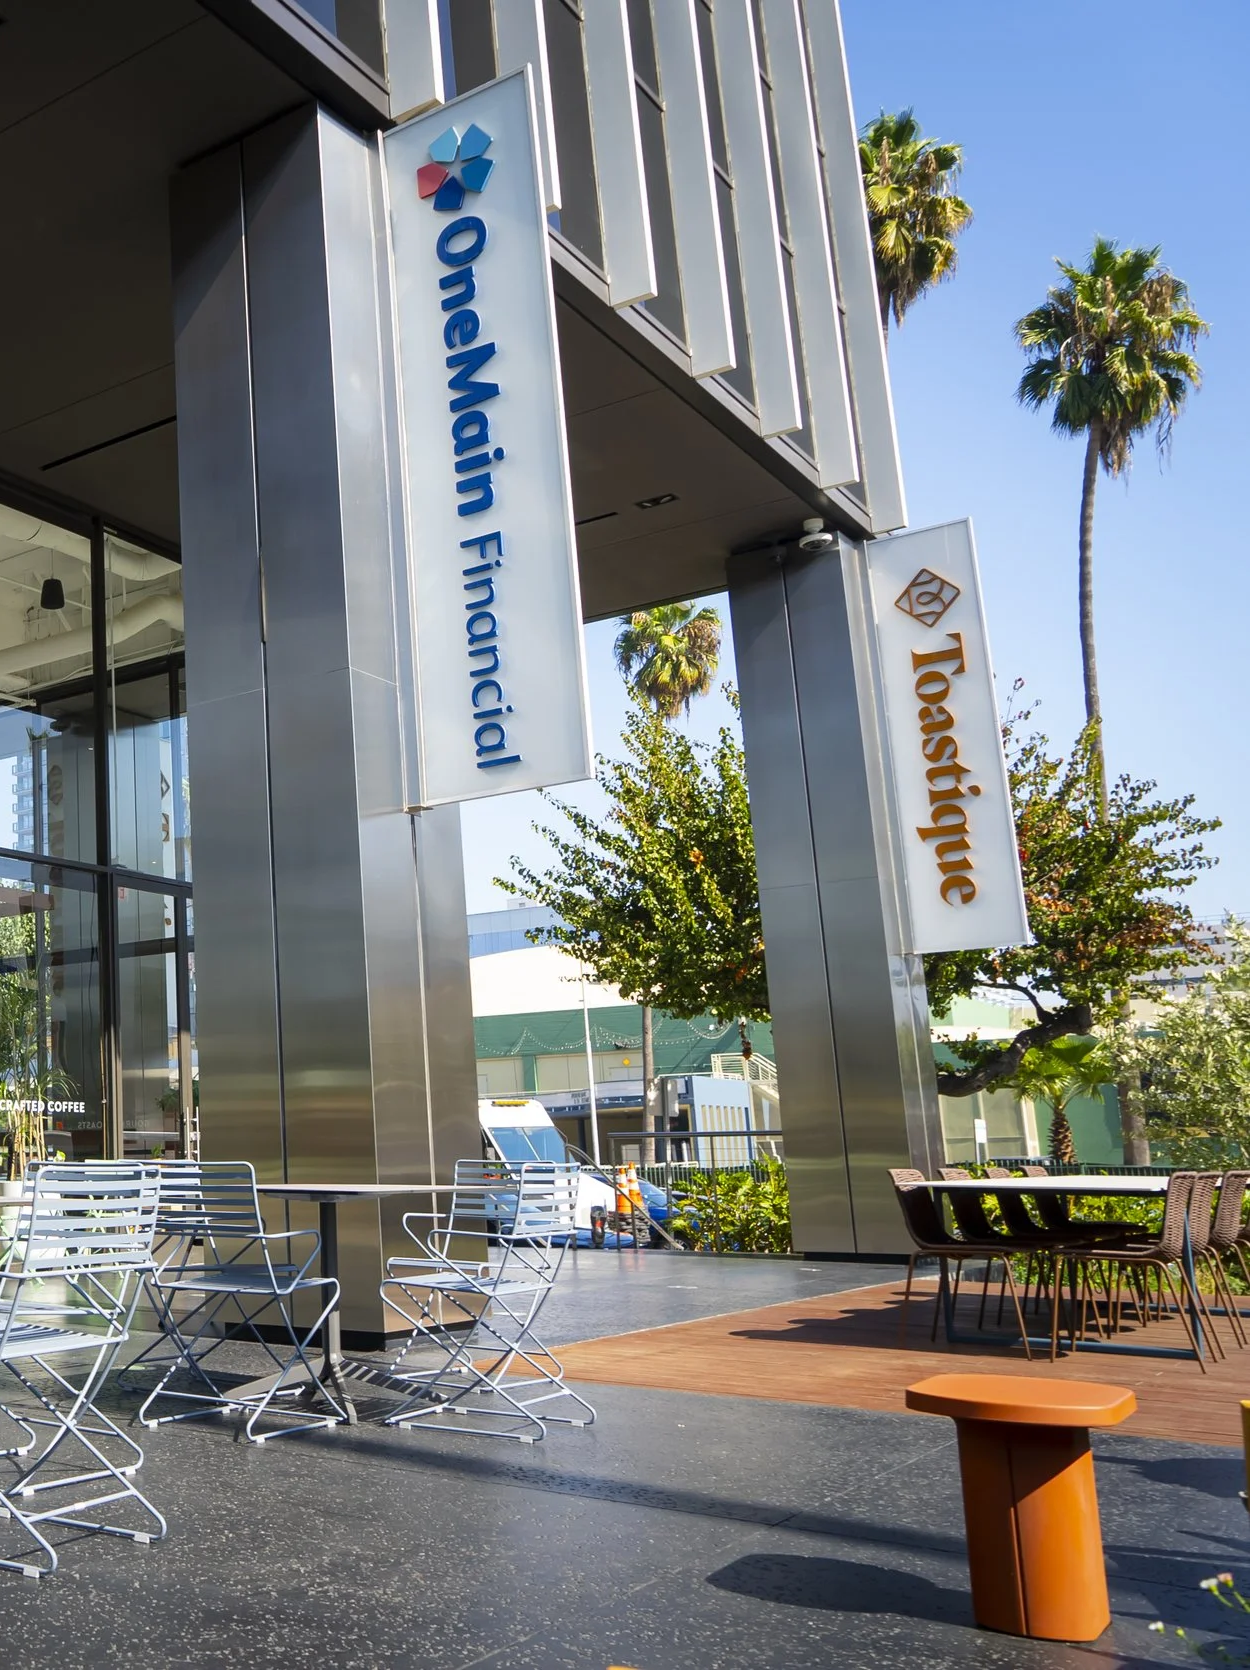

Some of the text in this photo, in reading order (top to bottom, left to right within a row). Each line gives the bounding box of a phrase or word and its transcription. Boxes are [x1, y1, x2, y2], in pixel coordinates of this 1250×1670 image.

[435, 215, 523, 770] OneMain Financial
[910, 632, 982, 908] Toastique
[47, 1100, 86, 1113] COFFEE
